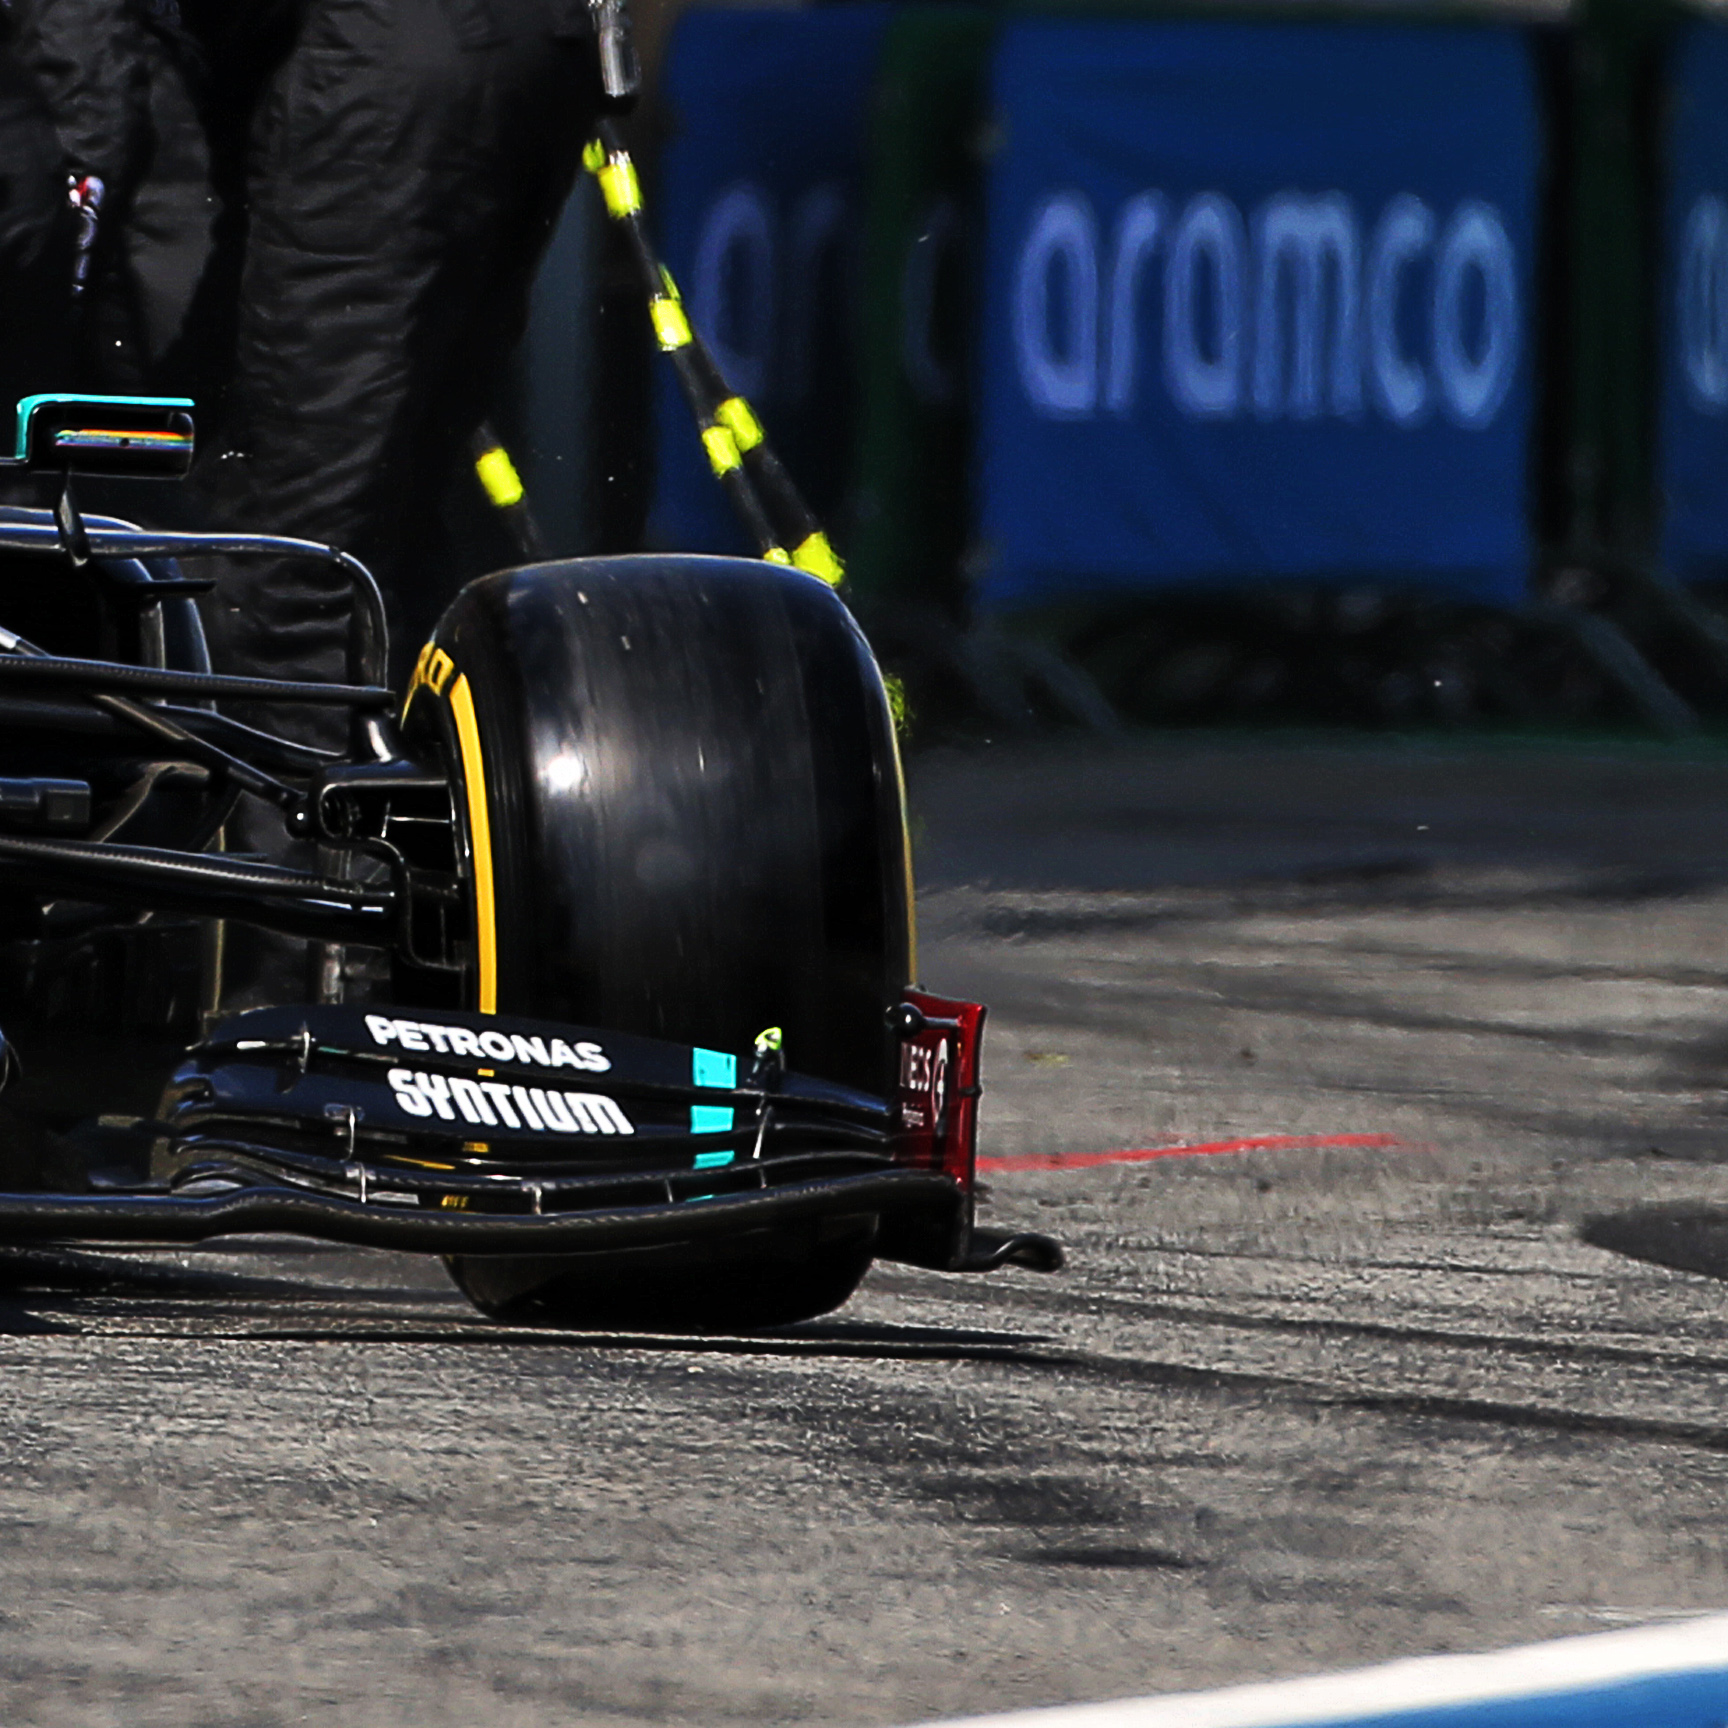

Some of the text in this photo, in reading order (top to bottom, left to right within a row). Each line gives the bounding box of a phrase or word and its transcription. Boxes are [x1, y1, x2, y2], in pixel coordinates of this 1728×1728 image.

[1014, 188, 1518, 429] aramco
[364, 1014, 612, 1073] PETRONAS
[388, 1068, 636, 1135] SYNTIUM
